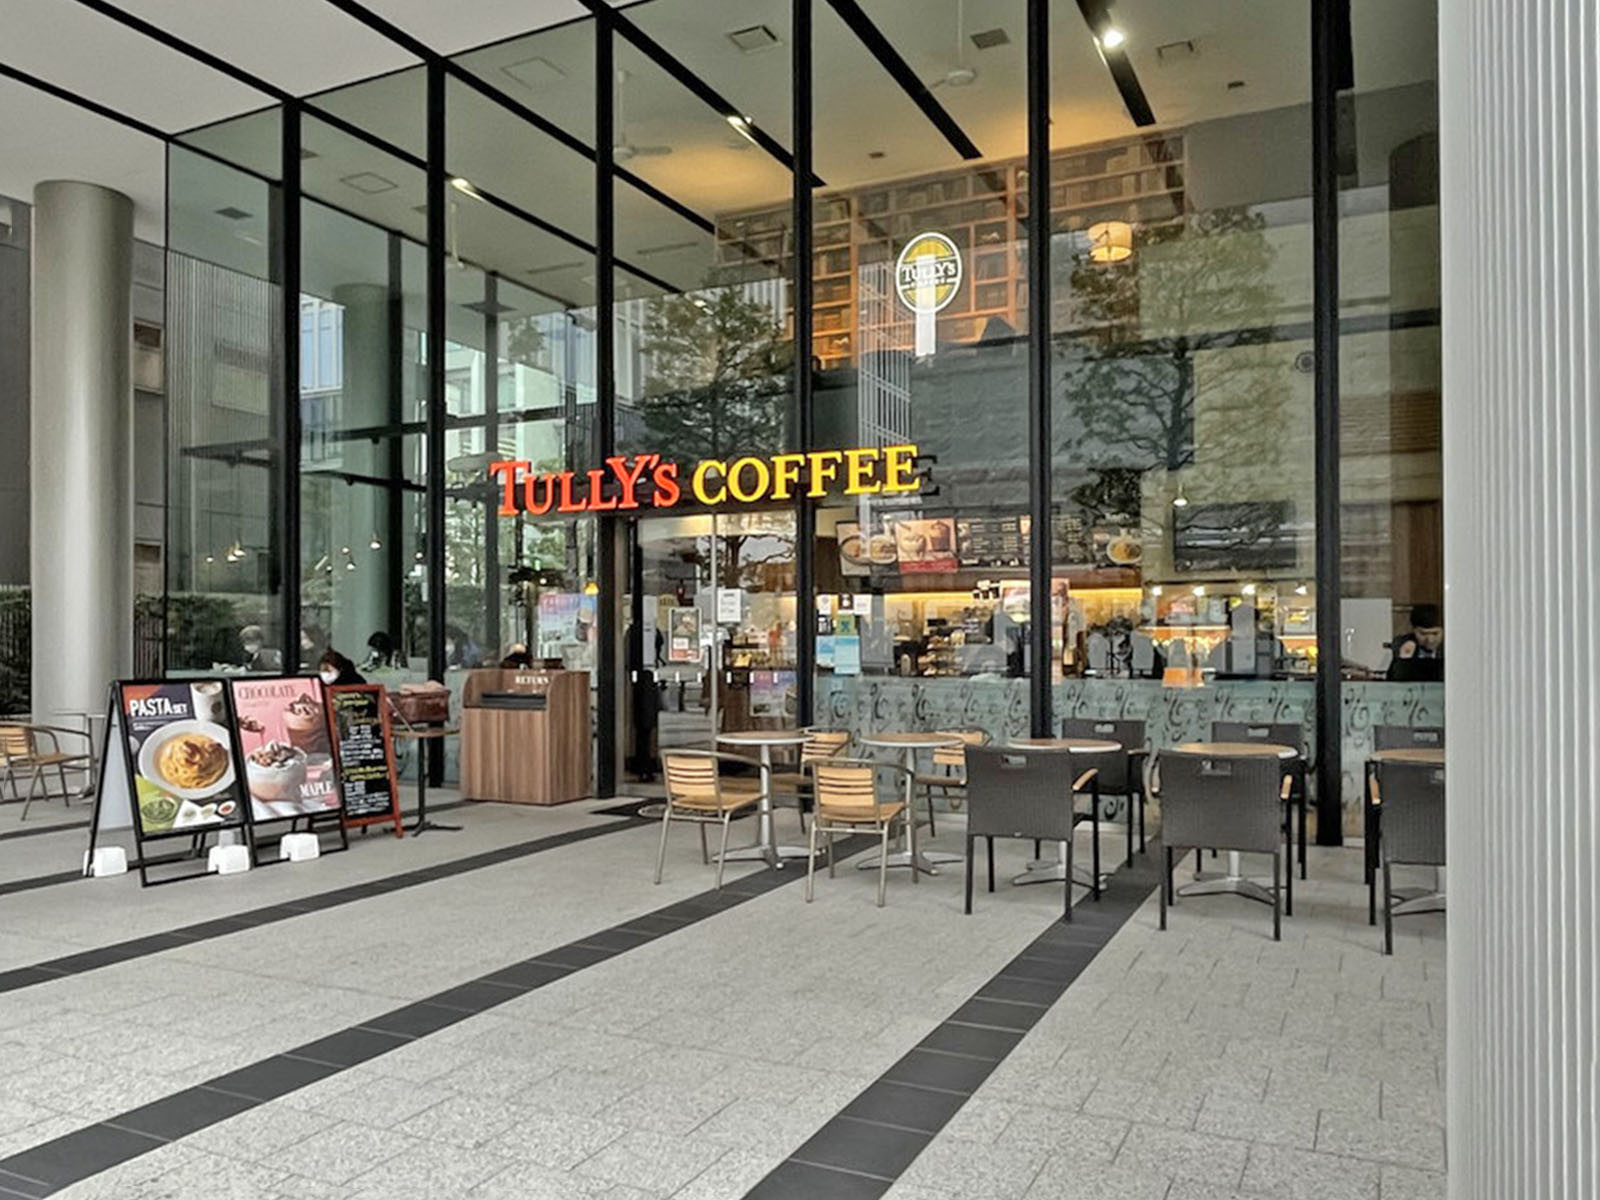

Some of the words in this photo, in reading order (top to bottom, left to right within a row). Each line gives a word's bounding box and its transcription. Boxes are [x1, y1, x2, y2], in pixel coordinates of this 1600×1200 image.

[692, 445, 921, 505] COFFEE
[515, 675, 550, 685] RETURN
[237, 685, 297, 700] CHOCOLATE
[129, 698, 172, 717] PASTA
[299, 780, 333, 798] MAPLE
